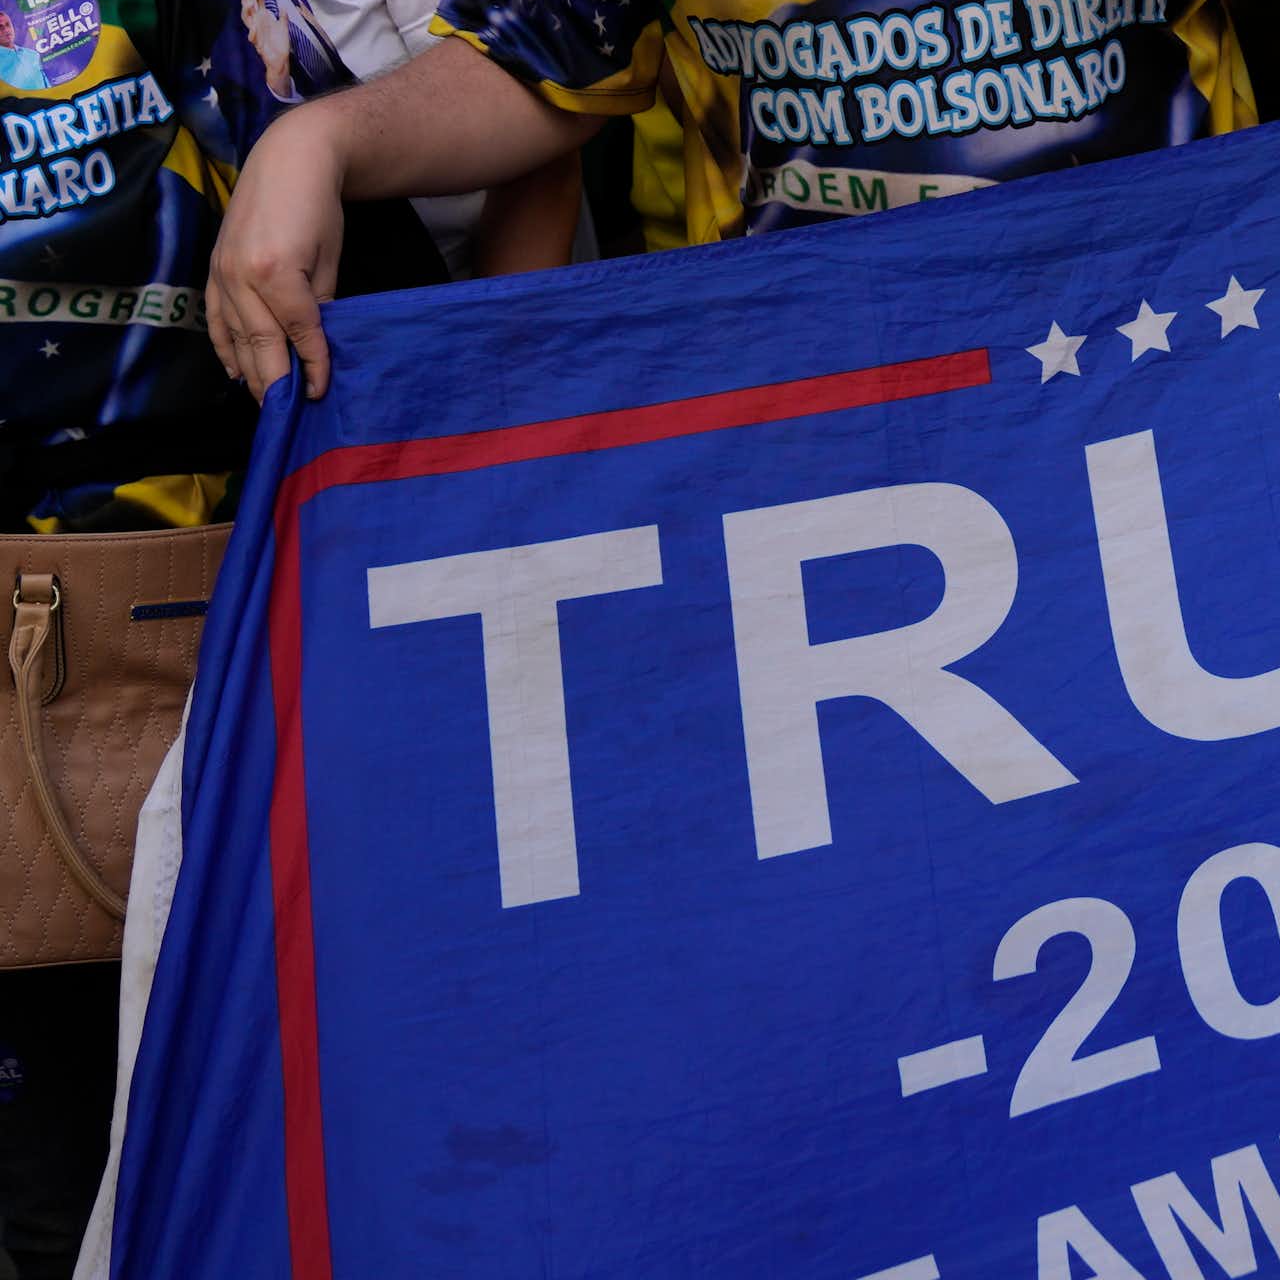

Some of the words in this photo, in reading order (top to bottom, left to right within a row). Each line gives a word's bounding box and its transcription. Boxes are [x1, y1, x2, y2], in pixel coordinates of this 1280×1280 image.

[35, 16, 99, 53] CASAL
[697, 8, 949, 82] ADVOGADOS
[2, 71, 175, 162] DIREITA
[751, 85, 852, 144] COM
[856, 40, 1127, 142] BOLSONARO
